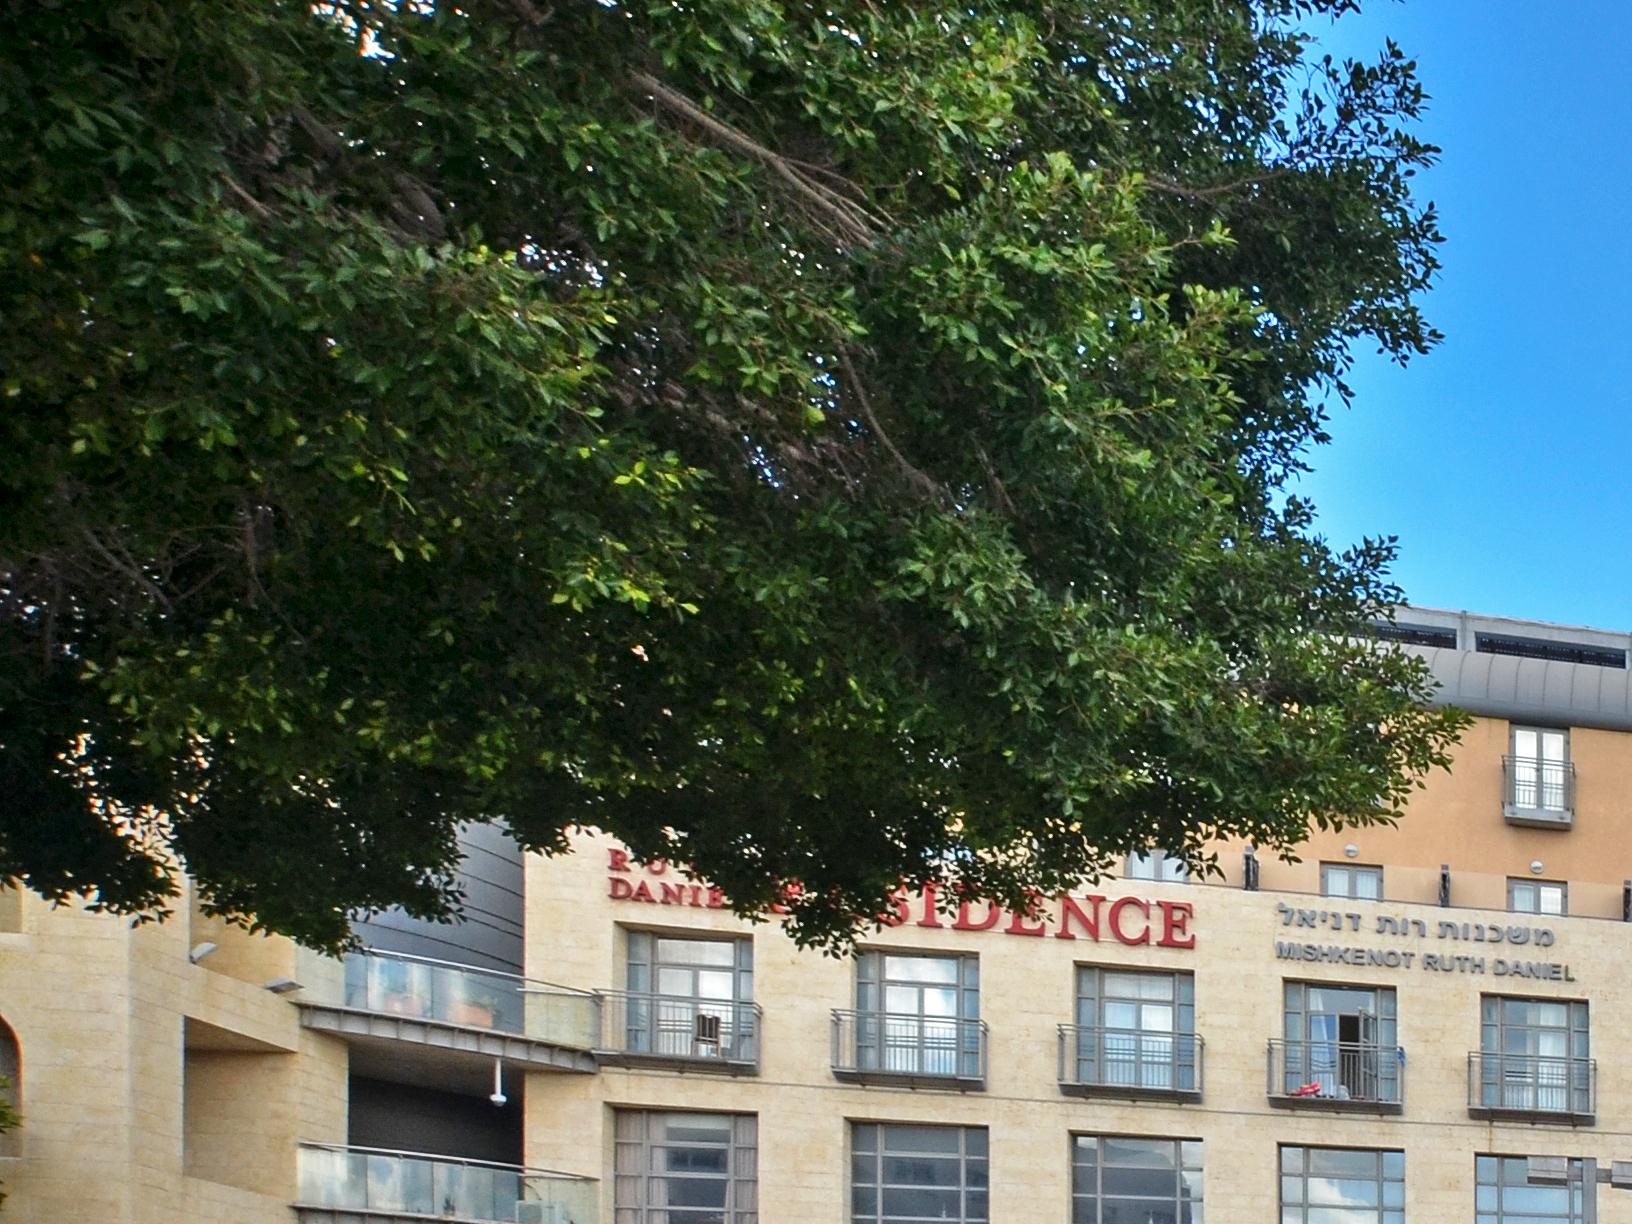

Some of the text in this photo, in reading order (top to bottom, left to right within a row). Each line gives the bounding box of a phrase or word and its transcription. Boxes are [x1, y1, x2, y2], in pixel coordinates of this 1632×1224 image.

[607, 876, 725, 908] DANIE
[1277, 902, 1555, 947] משכנות רות דניאל
[1276, 941, 1576, 983] MISHKENOT RUTH DANIEL
